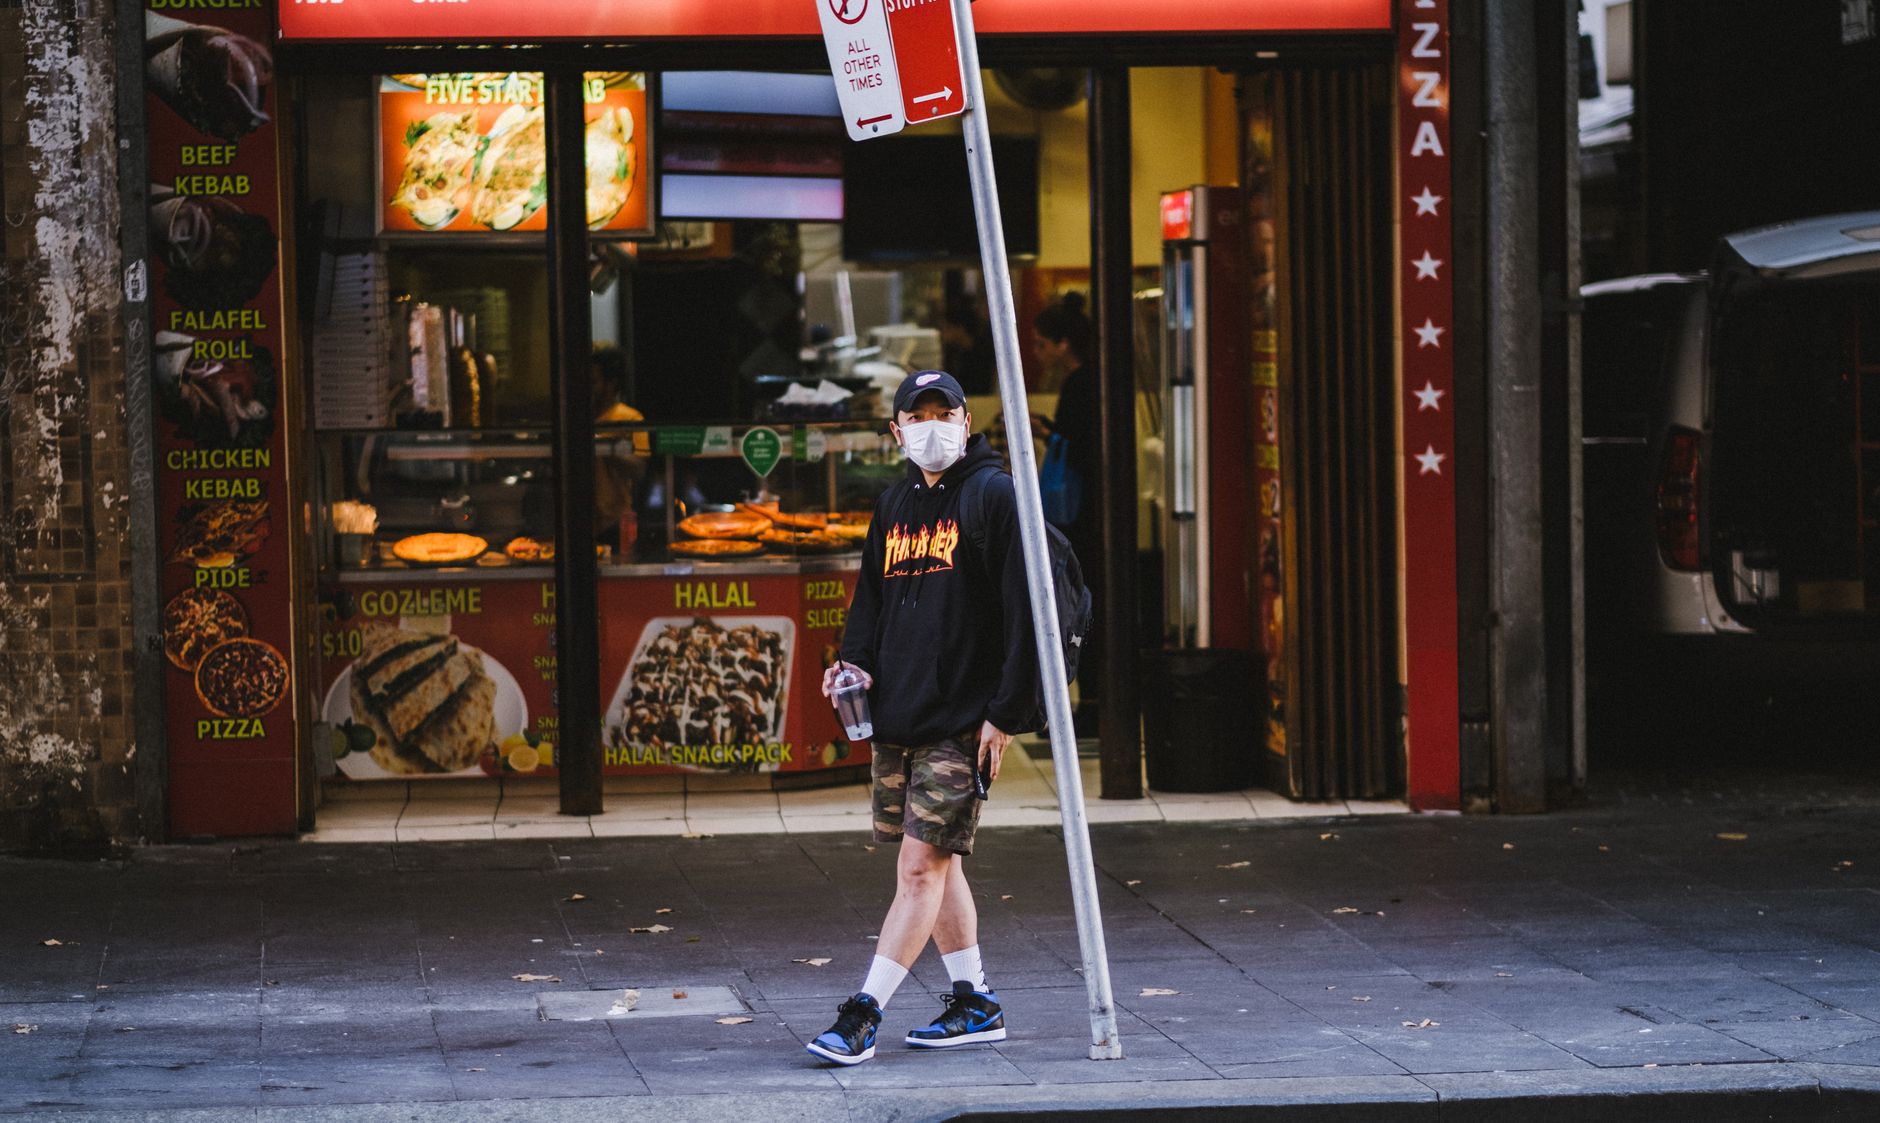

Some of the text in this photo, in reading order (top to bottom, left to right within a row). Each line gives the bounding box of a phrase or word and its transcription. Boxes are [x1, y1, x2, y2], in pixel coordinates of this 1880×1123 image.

[847, 38, 871, 55] ALL
[844, 54, 881, 75] OTHER
[426, 79, 474, 105] FIVE
[477, 79, 534, 104] STAR
[849, 73, 883, 92] TIMES
[181, 145, 237, 165] BEEF
[175, 175, 251, 196] KEBAB
[170, 310, 266, 331] FALAFEL
[194, 339, 253, 360] ROLL
[167, 448, 271, 470] CHICKEN
[185, 478, 260, 499] KEBAB
[885, 519, 959, 576] THRAHER
[195, 568, 251, 589] PIDE
[674, 581, 757, 609] HALAL
[806, 580, 846, 600] PIZZA
[360, 587, 482, 617] GOZLEME
[322, 629, 361, 660] $10
[197, 719, 266, 739] PIZZA
[604, 742, 793, 767] HALAL SNACK PACK
